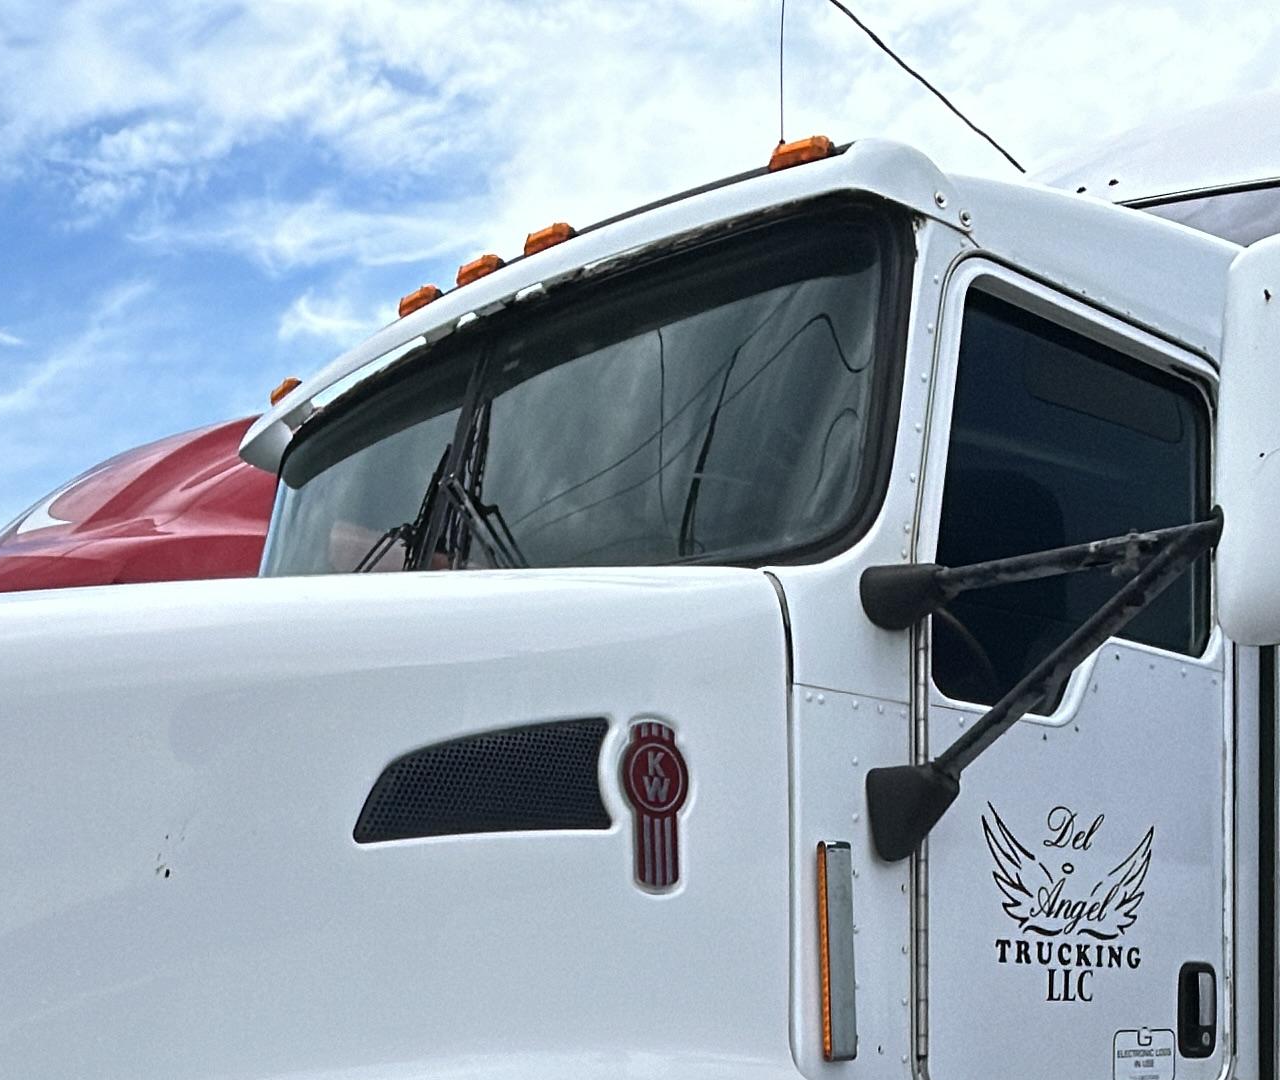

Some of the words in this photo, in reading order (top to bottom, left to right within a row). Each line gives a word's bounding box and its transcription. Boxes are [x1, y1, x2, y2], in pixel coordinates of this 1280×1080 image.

[1042, 805, 1105, 851] Del
[1029, 876, 1121, 935] Angel
[995, 938, 1143, 970] TRUCKING
[1045, 967, 1095, 1002] LLC
